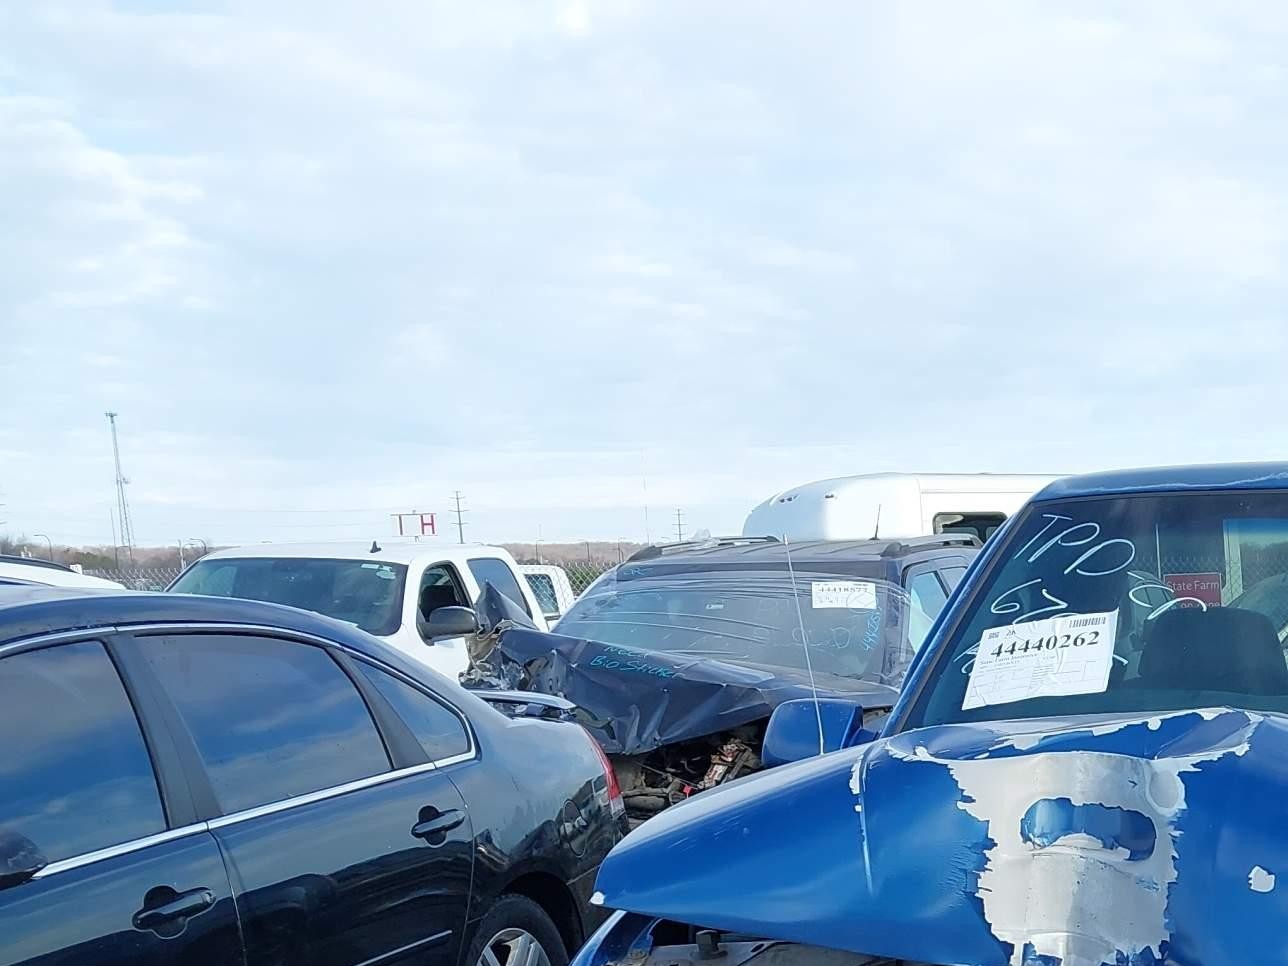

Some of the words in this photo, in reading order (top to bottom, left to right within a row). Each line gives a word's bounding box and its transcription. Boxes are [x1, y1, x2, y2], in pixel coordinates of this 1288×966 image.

[420, 514, 436, 535] H
[1166, 581, 1193, 591] State
[1194, 580, 1220, 592] Farm
[990, 630, 1100, 658] 44440262
